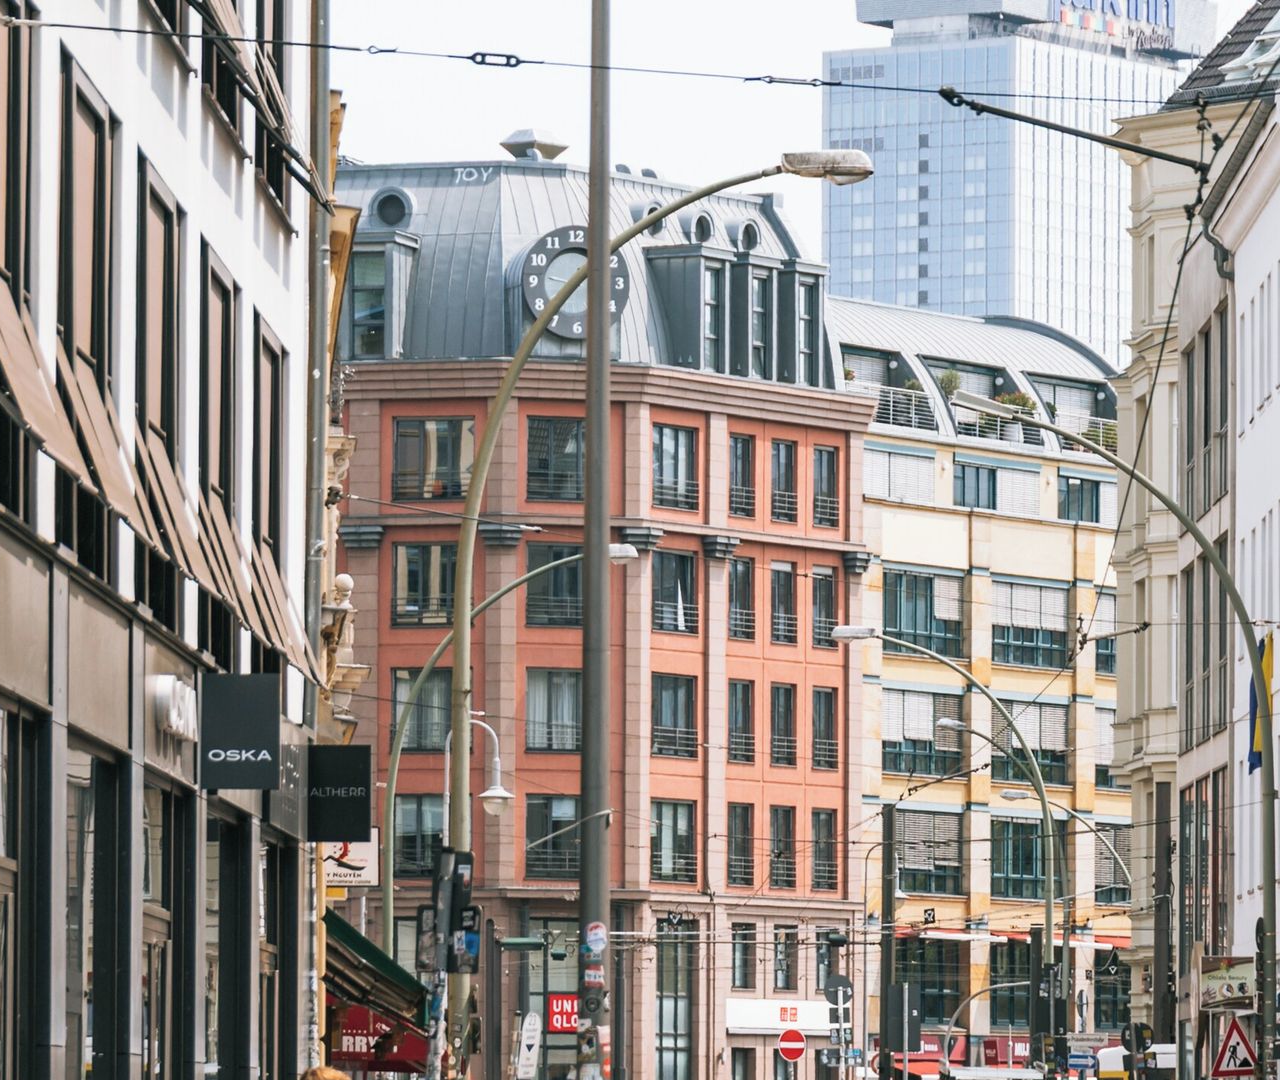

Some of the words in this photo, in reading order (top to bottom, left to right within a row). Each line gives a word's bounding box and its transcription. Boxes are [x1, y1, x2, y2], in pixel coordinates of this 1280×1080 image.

[568, 230, 584, 243] 12
[546, 237, 560, 249] 11
[531, 254, 547, 266] 10
[609, 256, 619, 268] 2
[529, 275, 538, 287] 9
[615, 277, 624, 289] 3
[535, 298, 545, 311] 8
[572, 322, 582, 334] 6
[208, 749, 272, 762] OSKA
[310, 786, 366, 798] ALTHERR
[553, 999, 578, 1012] UNI
[553, 1014, 578, 1028] QLO
